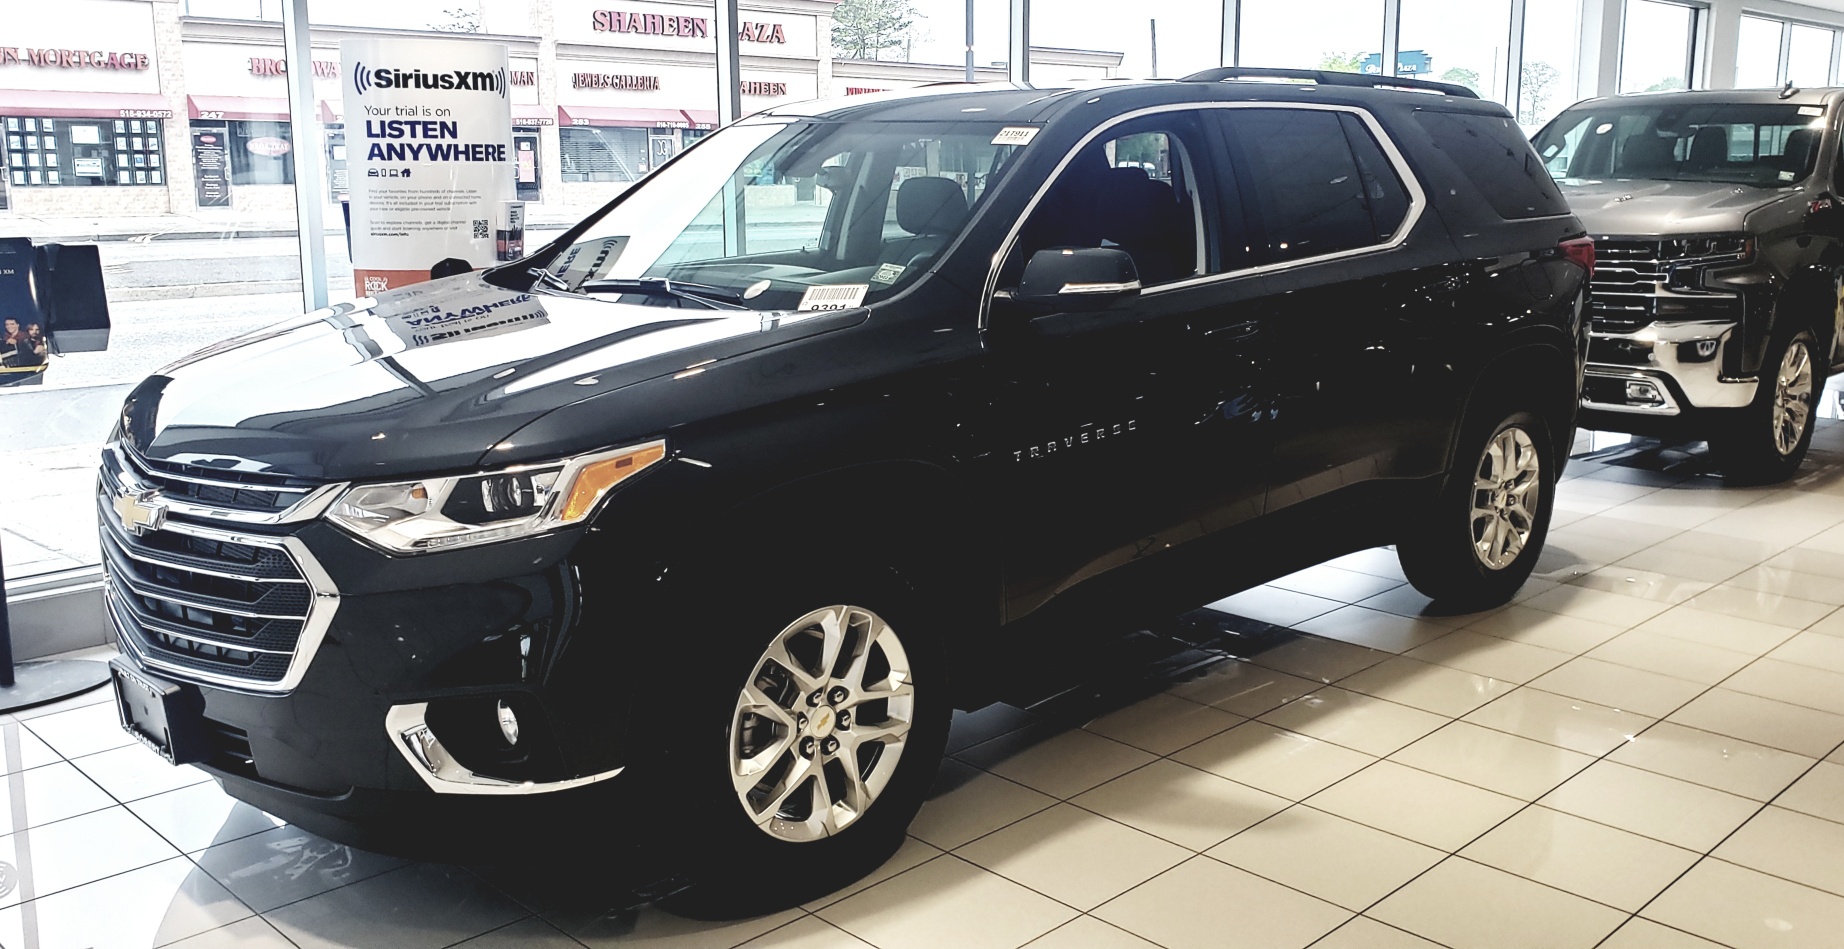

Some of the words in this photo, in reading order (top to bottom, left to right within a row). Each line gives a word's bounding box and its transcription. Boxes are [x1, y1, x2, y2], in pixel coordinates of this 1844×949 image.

[593, 10, 709, 38] SHAHEEN
[0, 47, 19, 65] N
[26, 48, 149, 70] MORTGAGE
[572, 73, 610, 89] JEWELS
[740, 81, 787, 95] AHEEN
[200, 111, 224, 119] 247
[364, 105, 391, 116] Your
[395, 105, 418, 117] trial
[422, 106, 431, 116] is
[436, 108, 451, 117] on
[366, 120, 458, 139] LISTEN
[367, 142, 506, 162] ANYWHERE
[365, 281, 388, 291] ROCK
[1013, 420, 1136, 462] TRAVERSE
